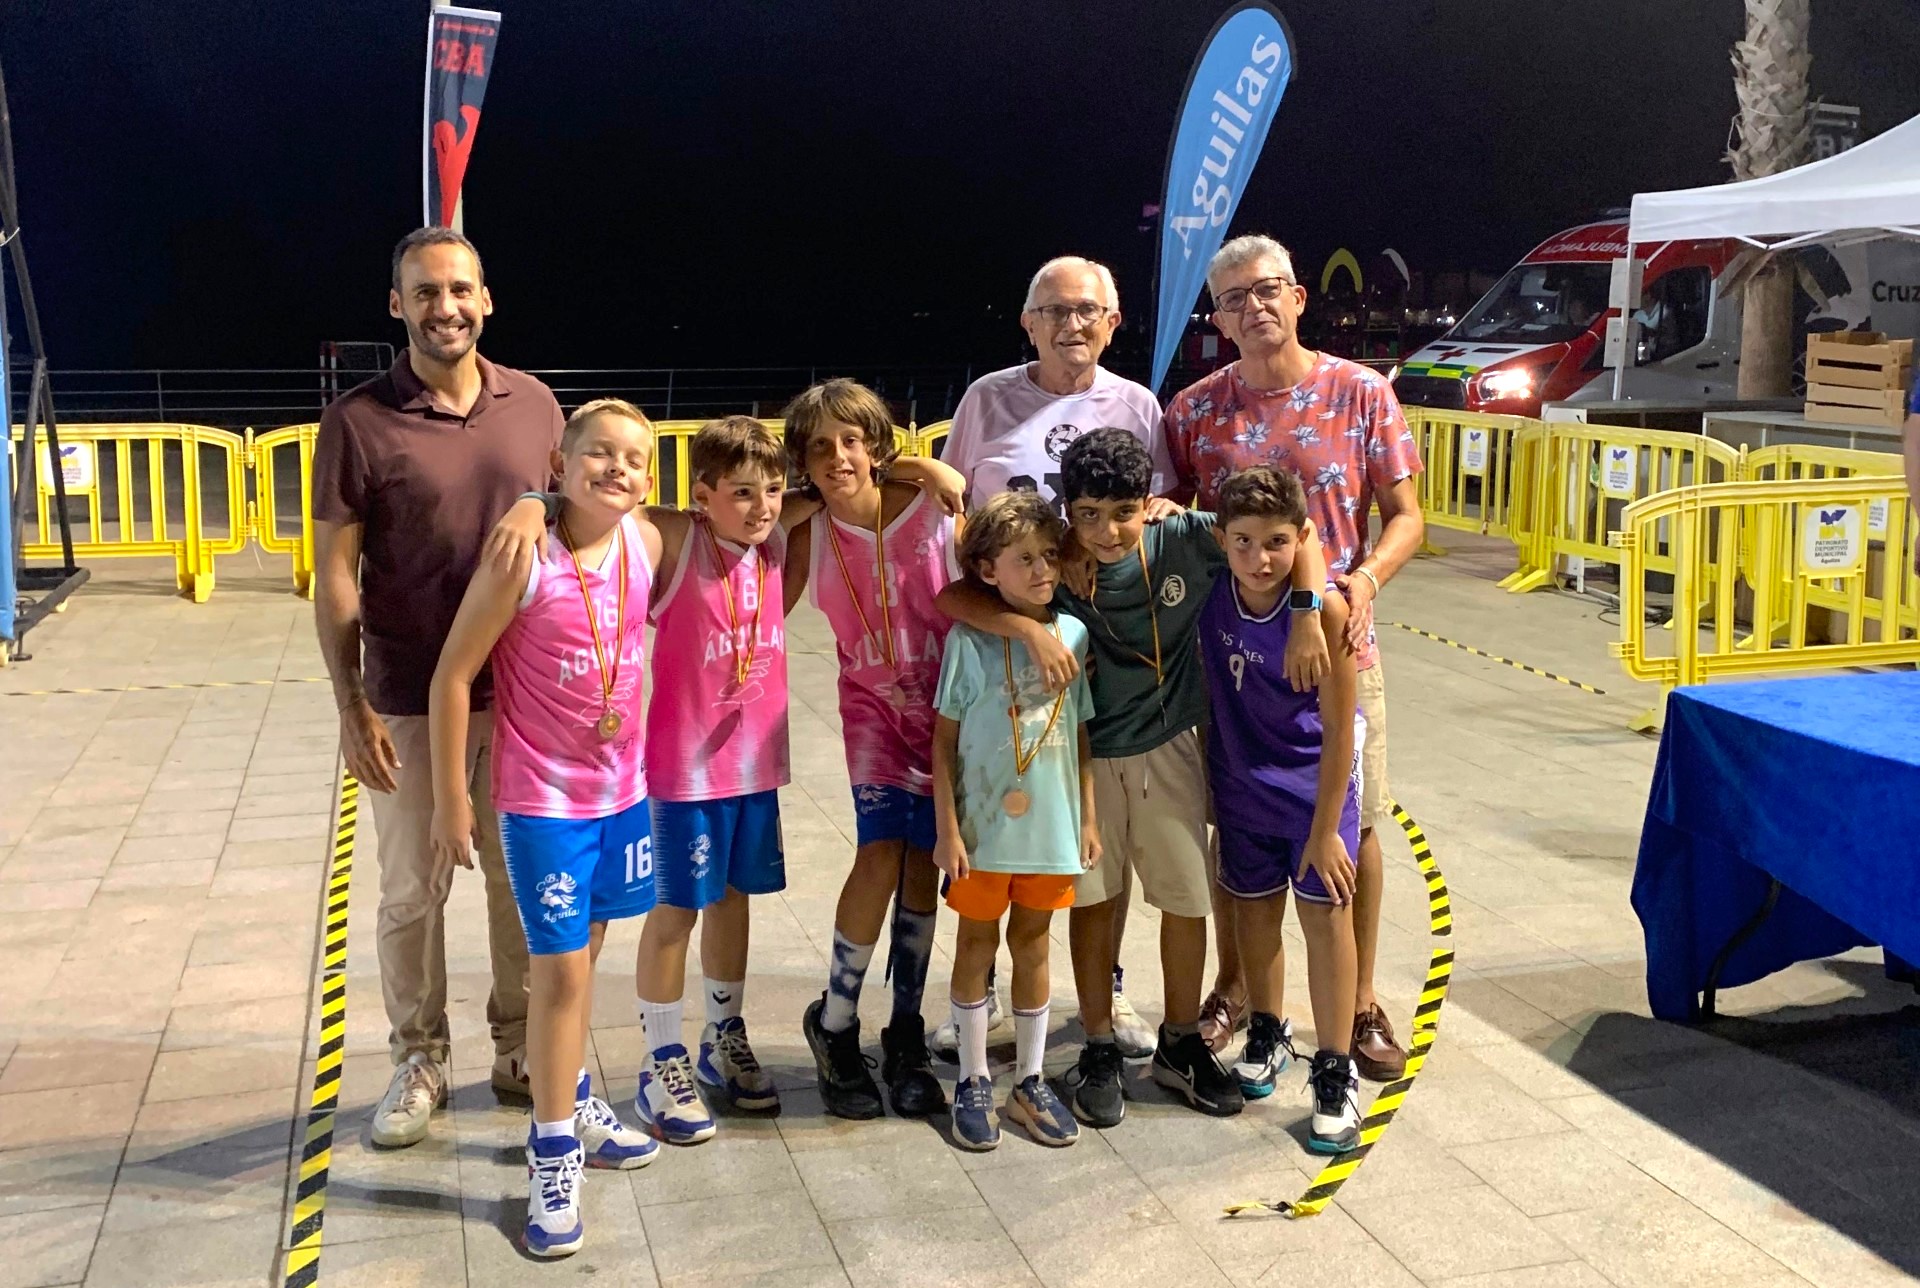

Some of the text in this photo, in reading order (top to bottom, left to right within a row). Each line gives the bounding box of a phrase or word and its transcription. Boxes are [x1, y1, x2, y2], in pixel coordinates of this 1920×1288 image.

[1872, 280, 1920, 302] Cruz
[593, 594, 619, 630] 16
[743, 579, 758, 610] 6
[1229, 653, 1245, 692] 9
[624, 835, 652, 884] 16
